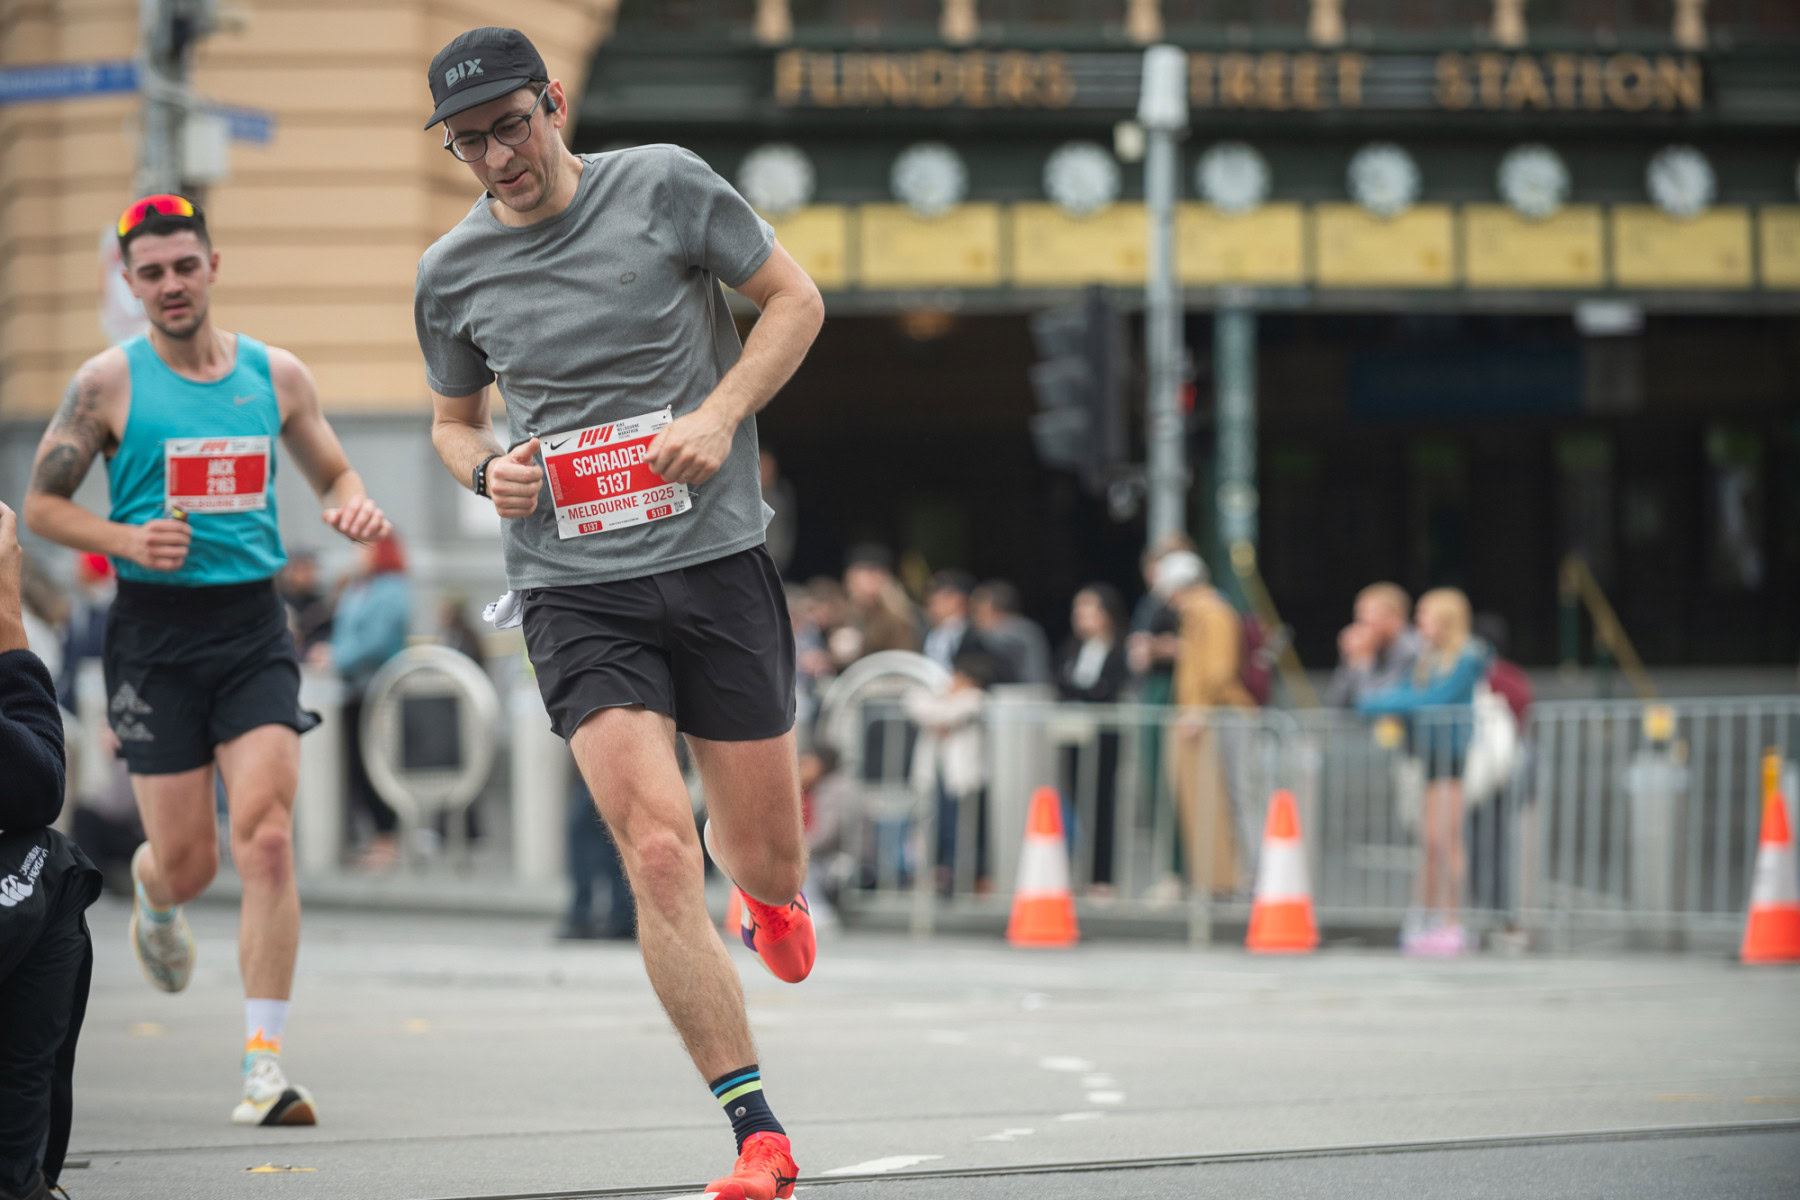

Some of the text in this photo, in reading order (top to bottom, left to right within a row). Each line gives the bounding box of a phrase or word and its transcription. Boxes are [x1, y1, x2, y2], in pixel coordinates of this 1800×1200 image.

[445, 58, 484, 89] BIX
[774, 51, 1703, 111] FLINDERS TREET STATION
[572, 444, 648, 477] SCHRADER
[596, 470, 632, 495] 5137
[567, 486, 675, 520] MELBOURNE 2025
[651, 506, 668, 518] 5137
[582, 522, 599, 533] 5137
